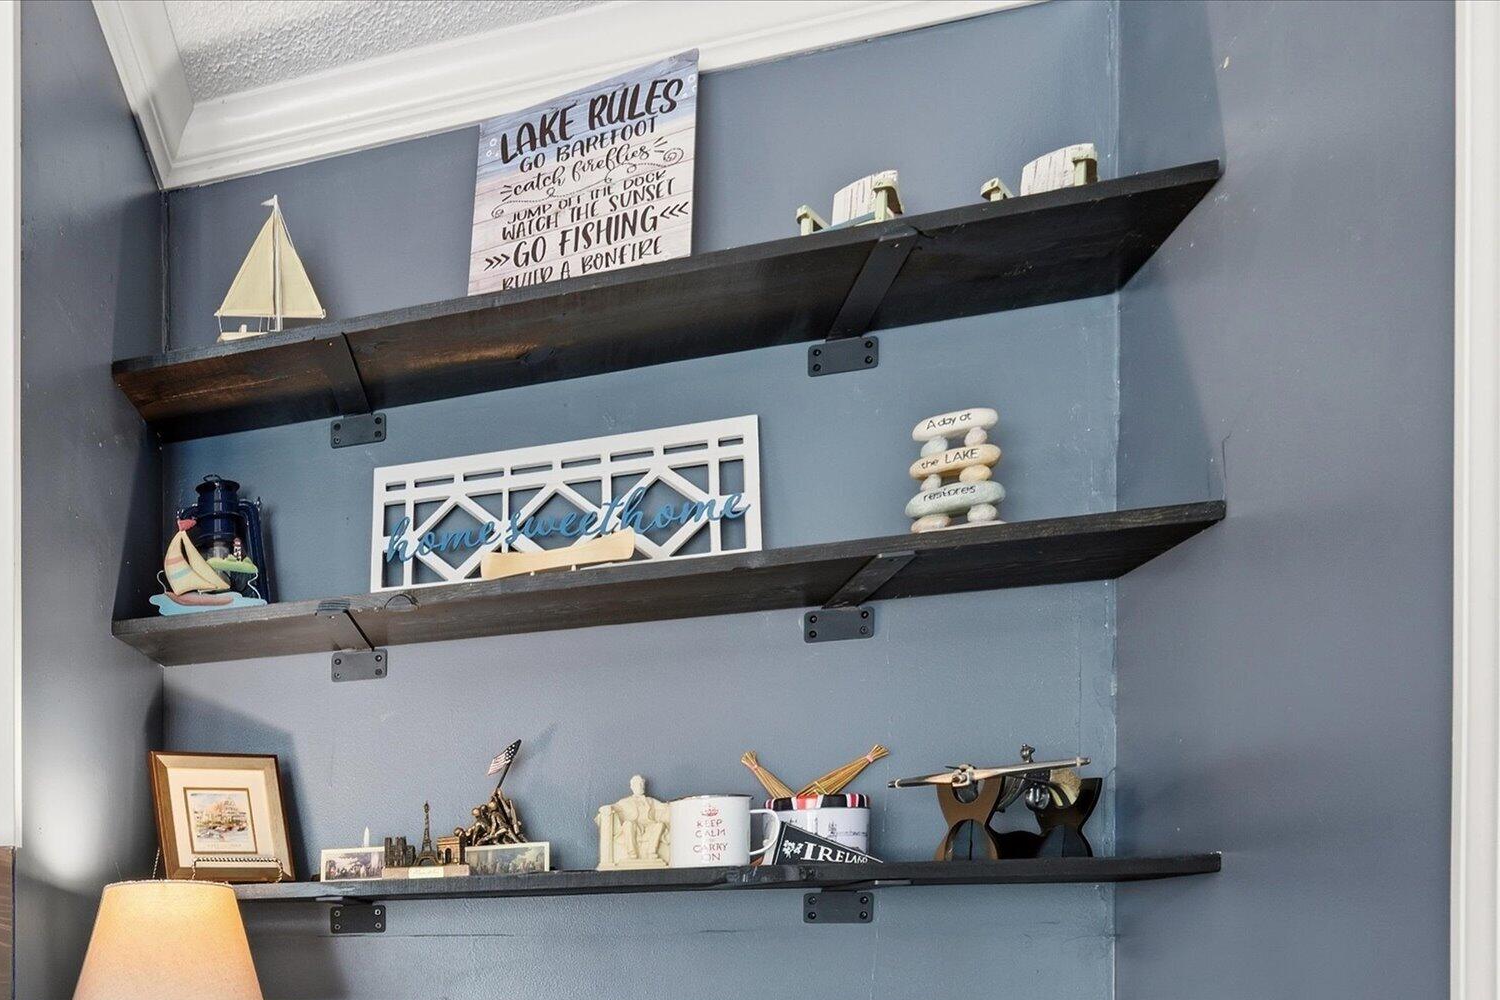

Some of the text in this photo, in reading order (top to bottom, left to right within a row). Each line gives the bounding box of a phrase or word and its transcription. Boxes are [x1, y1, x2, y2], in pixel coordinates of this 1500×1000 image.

[501, 78, 683, 164] LAKE RULES
[520, 116, 658, 173] GO BAREFOOT
[513, 143, 650, 196] catch fireflies
[502, 178, 675, 240] WATCH THE SUNSET
[507, 204, 552, 223] JUMP
[558, 195, 581, 211] OFF
[623, 170, 666, 189] DOCK
[513, 206, 658, 268] GO FISHING
[561, 260, 570, 280] A
[582, 236, 662, 274] BONFIRE
[926, 413, 972, 430] A day at
[945, 448, 980, 464] LAKE
[924, 485, 976, 501] restores
[387, 486, 752, 563] home sweet home
[695, 829, 725, 838] CALM
[696, 819, 722, 827] KEEP
[693, 843, 728, 852] CARRY
[701, 853, 720, 862] ON
[800, 842, 868, 863] IRELAND
